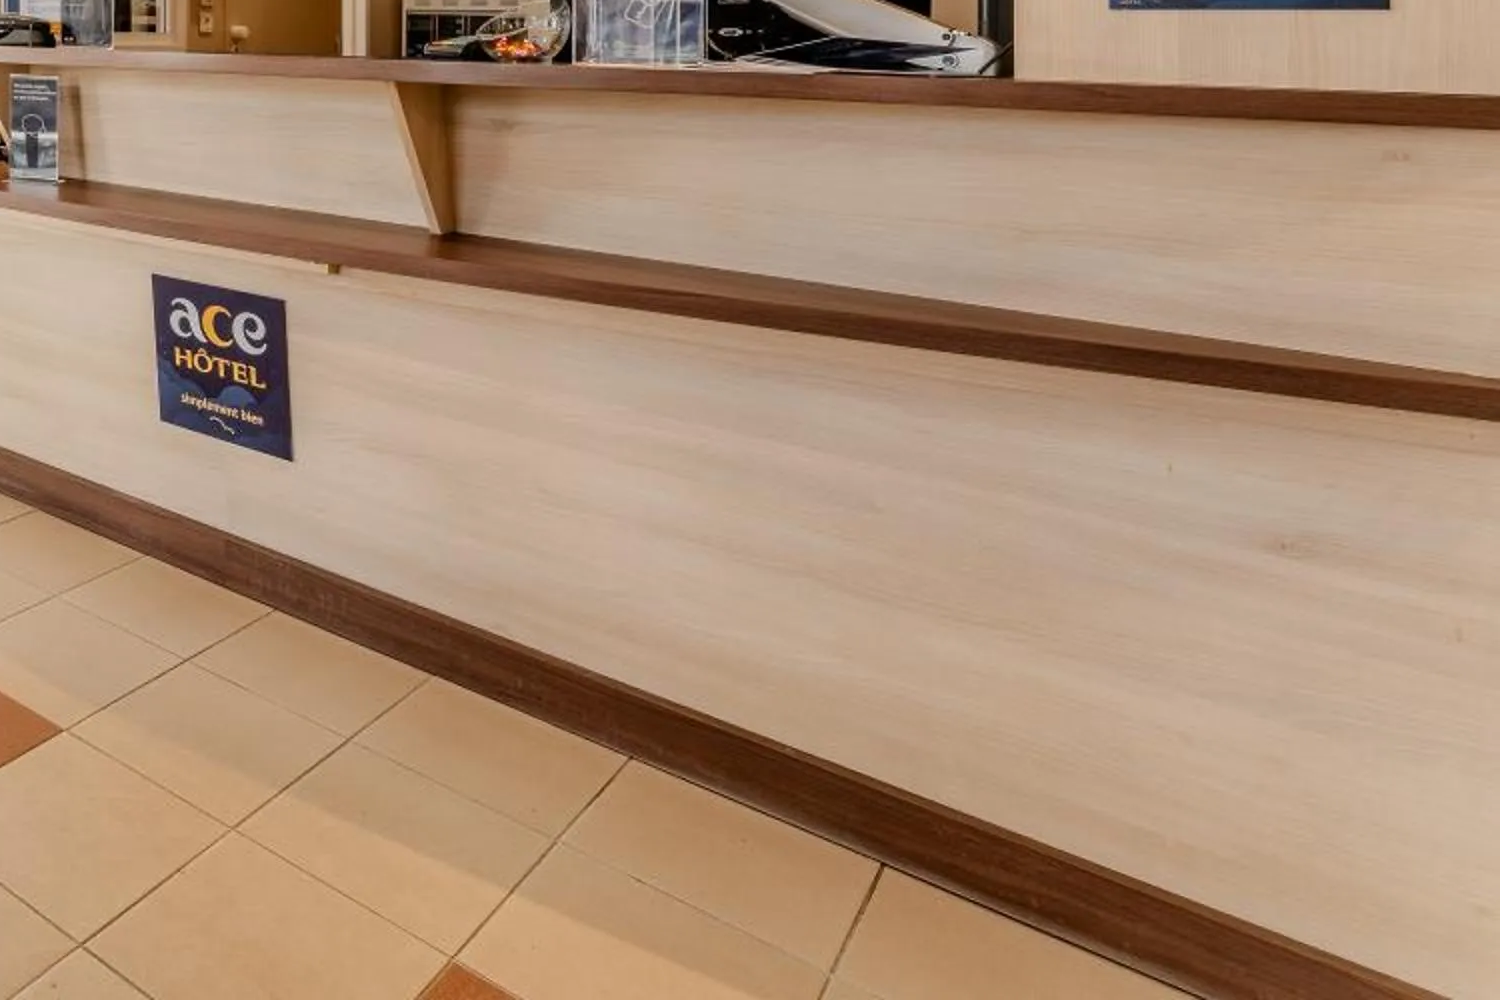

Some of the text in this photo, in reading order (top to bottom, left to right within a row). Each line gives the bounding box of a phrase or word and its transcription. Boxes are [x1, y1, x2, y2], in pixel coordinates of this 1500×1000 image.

[169, 297, 268, 355] ace
[174, 346, 267, 389] HÔTEL
[181, 391, 265, 426] simplement bien
